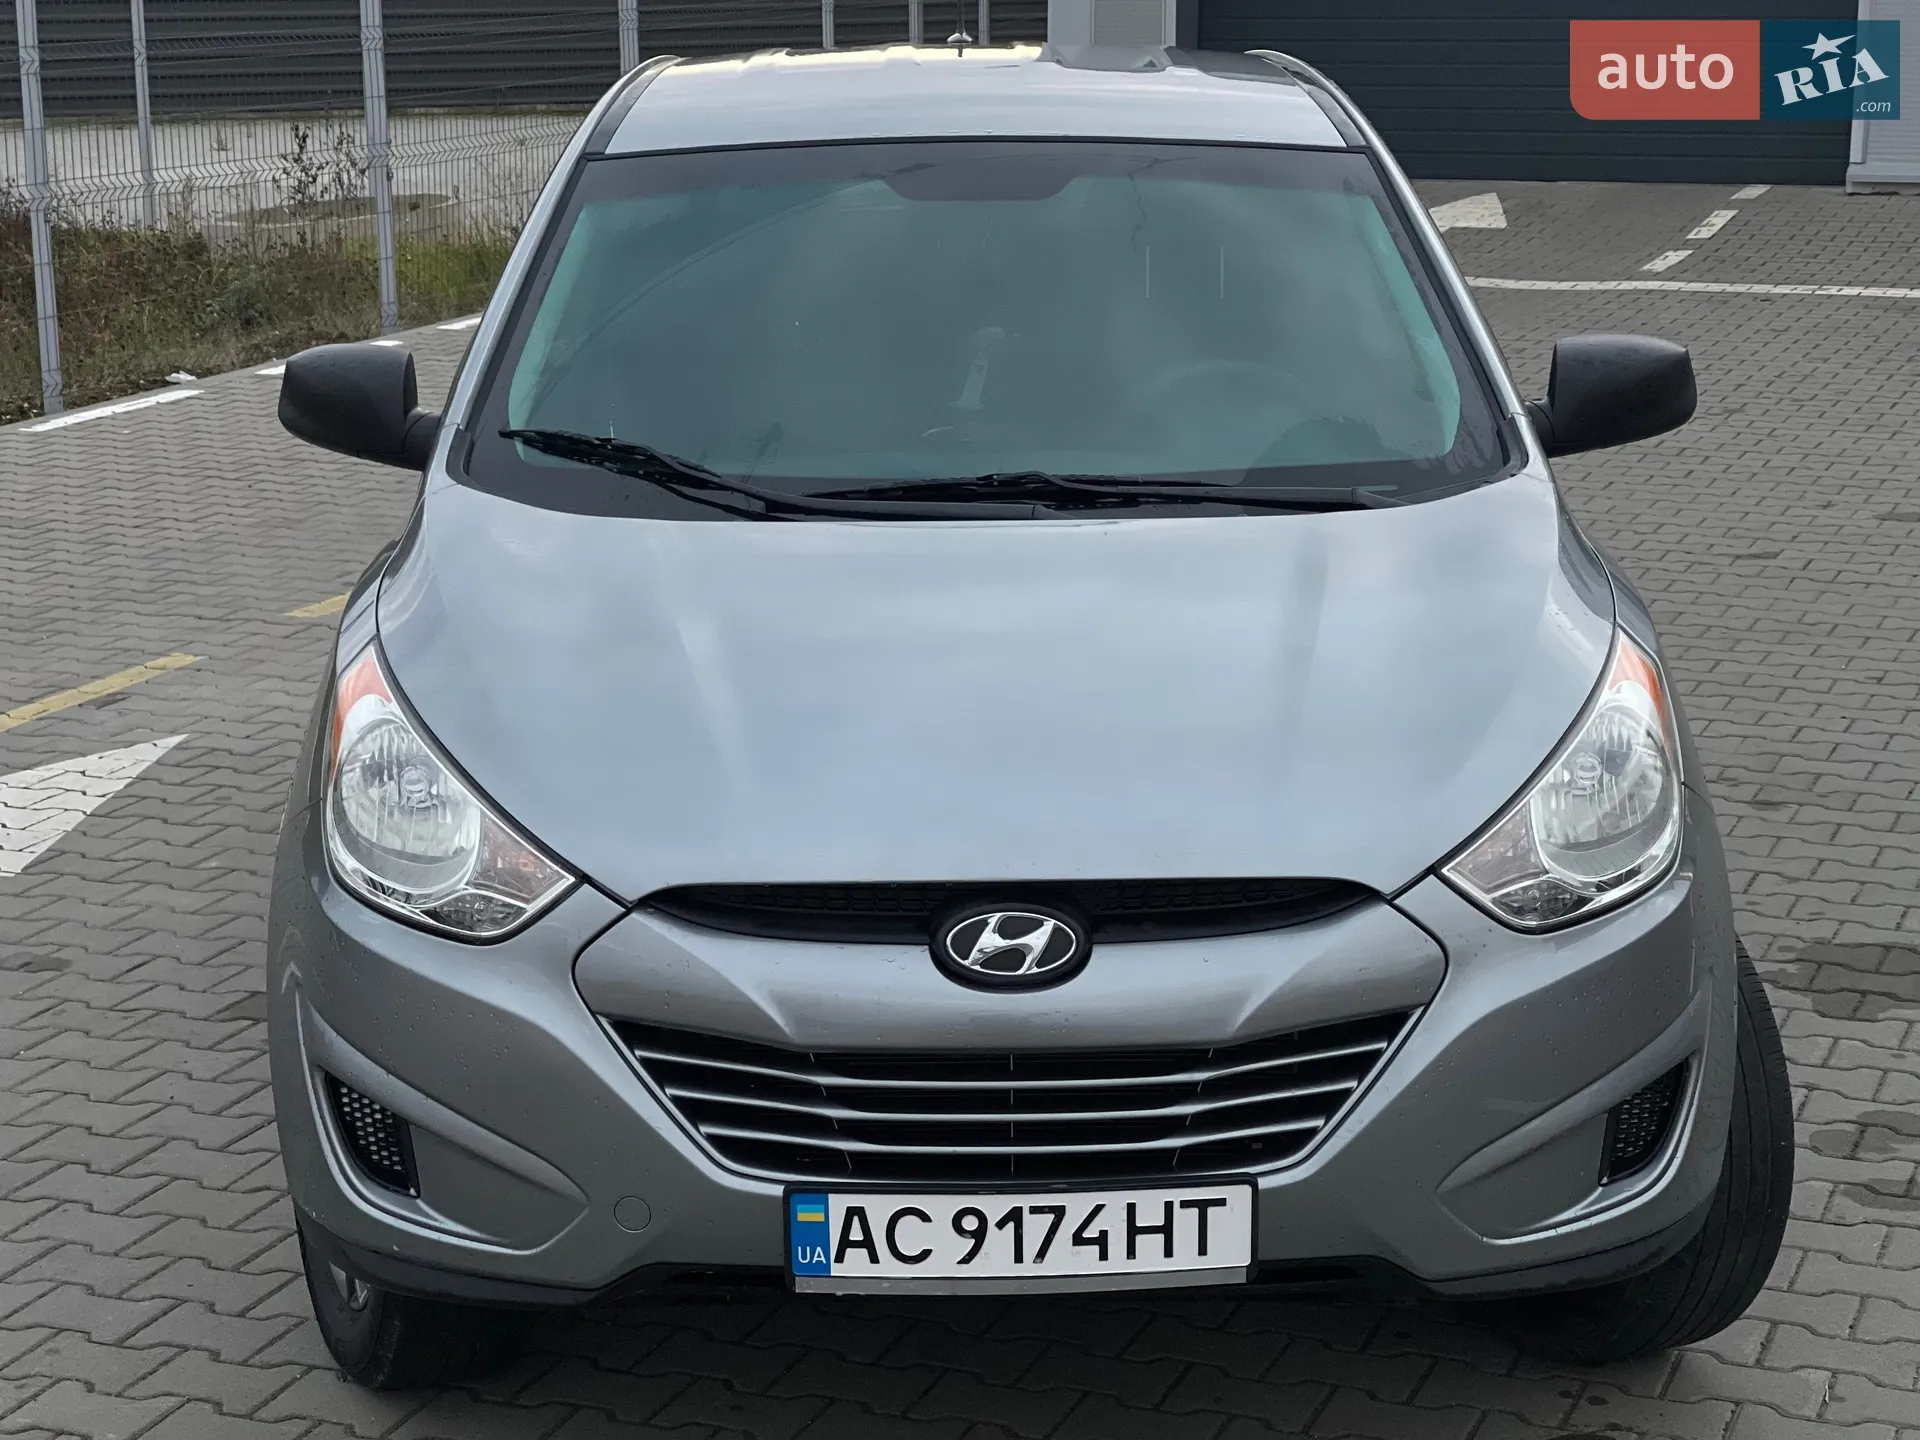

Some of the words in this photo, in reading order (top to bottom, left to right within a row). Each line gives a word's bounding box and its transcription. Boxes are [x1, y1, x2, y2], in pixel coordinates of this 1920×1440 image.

[833, 1205, 933, 1265] AC
[951, 1203, 1109, 1265] 9174
[1126, 1197, 1227, 1260] HT
[797, 1246, 827, 1264] UA
